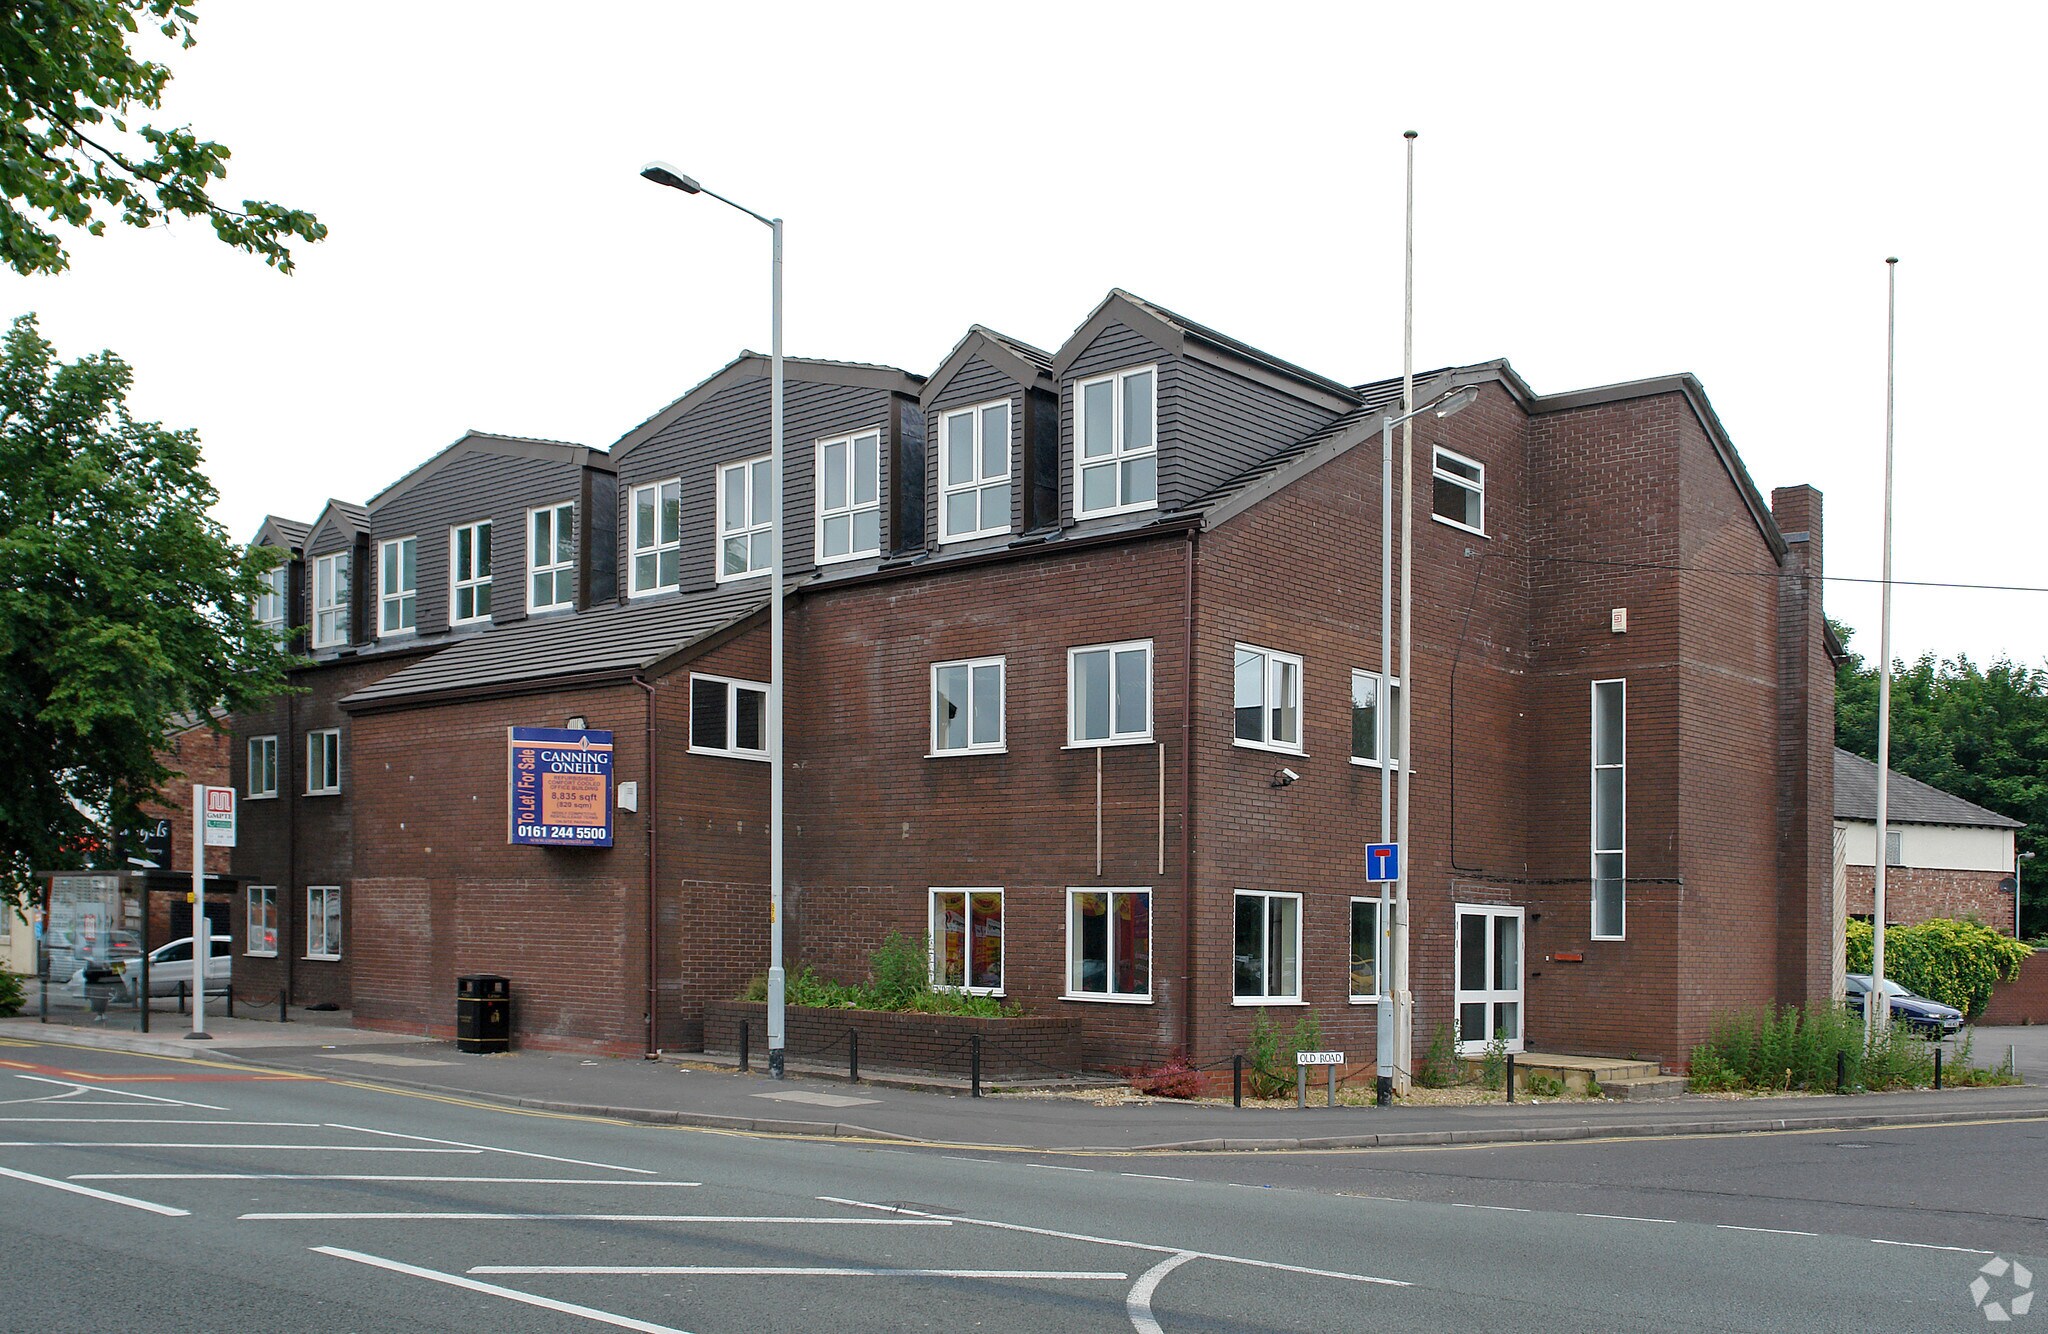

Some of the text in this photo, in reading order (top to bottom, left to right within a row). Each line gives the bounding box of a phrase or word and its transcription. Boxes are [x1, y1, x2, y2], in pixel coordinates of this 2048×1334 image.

[518, 749, 535, 770] Sale
[541, 751, 608, 763] CANNING
[551, 762, 601, 774] O'NEILL
[518, 772, 535, 788] For
[518, 795, 535, 810] Let
[579, 794, 598, 802] sqft
[518, 812, 535, 825] To
[518, 825, 606, 839] 0161 244 5500
[1300, 1054, 1341, 1063] OLD ROAD
